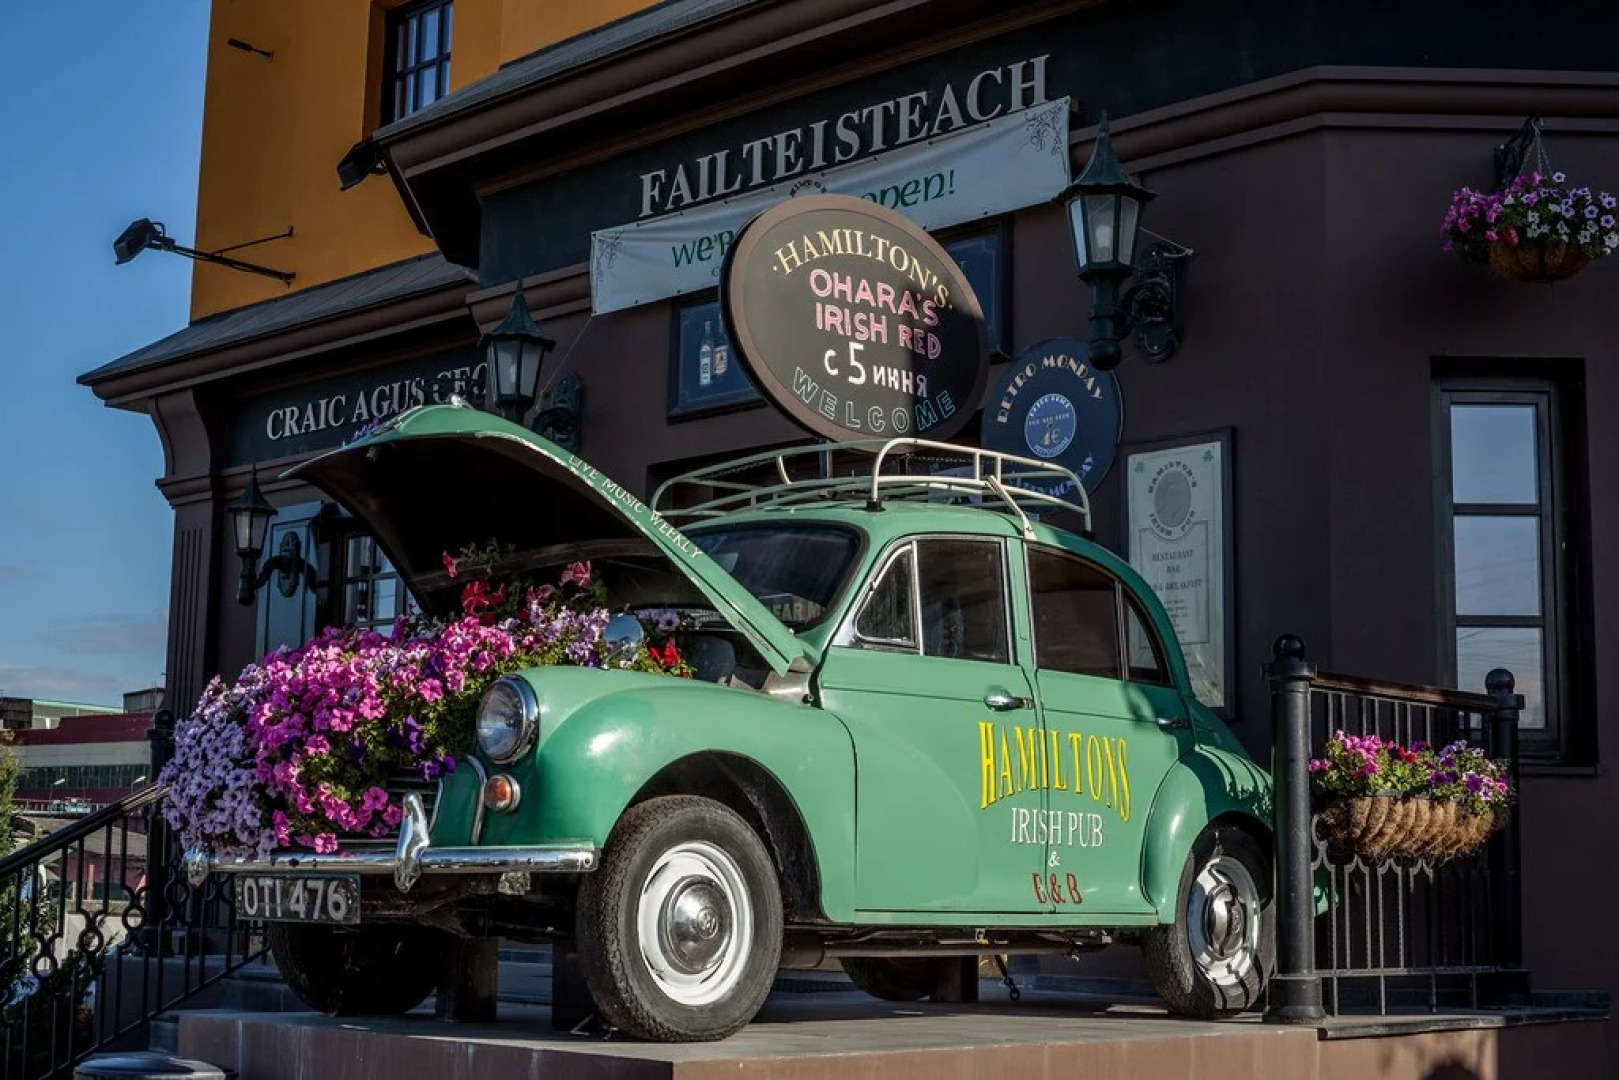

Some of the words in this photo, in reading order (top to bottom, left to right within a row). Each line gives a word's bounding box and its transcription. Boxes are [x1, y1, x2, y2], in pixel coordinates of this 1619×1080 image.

[809, 268, 939, 327] OHARA'S
[815, 302, 888, 344] IRISH
[897, 324, 942, 360] RED
[848, 341, 867, 385] 5
[1041, 354, 1103, 400] MONDAY
[266, 395, 347, 441] CRAIC
[352, 377, 426, 424] AGUS
[792, 366, 957, 433] WELCOME
[601, 478, 647, 514] MUSIC
[650, 509, 704, 559] WEEKLY
[1011, 807, 1063, 845] IRISH
[1068, 812, 1103, 848] PUB
[1048, 851, 1061, 867] &
[290, 879, 347, 920] 476
